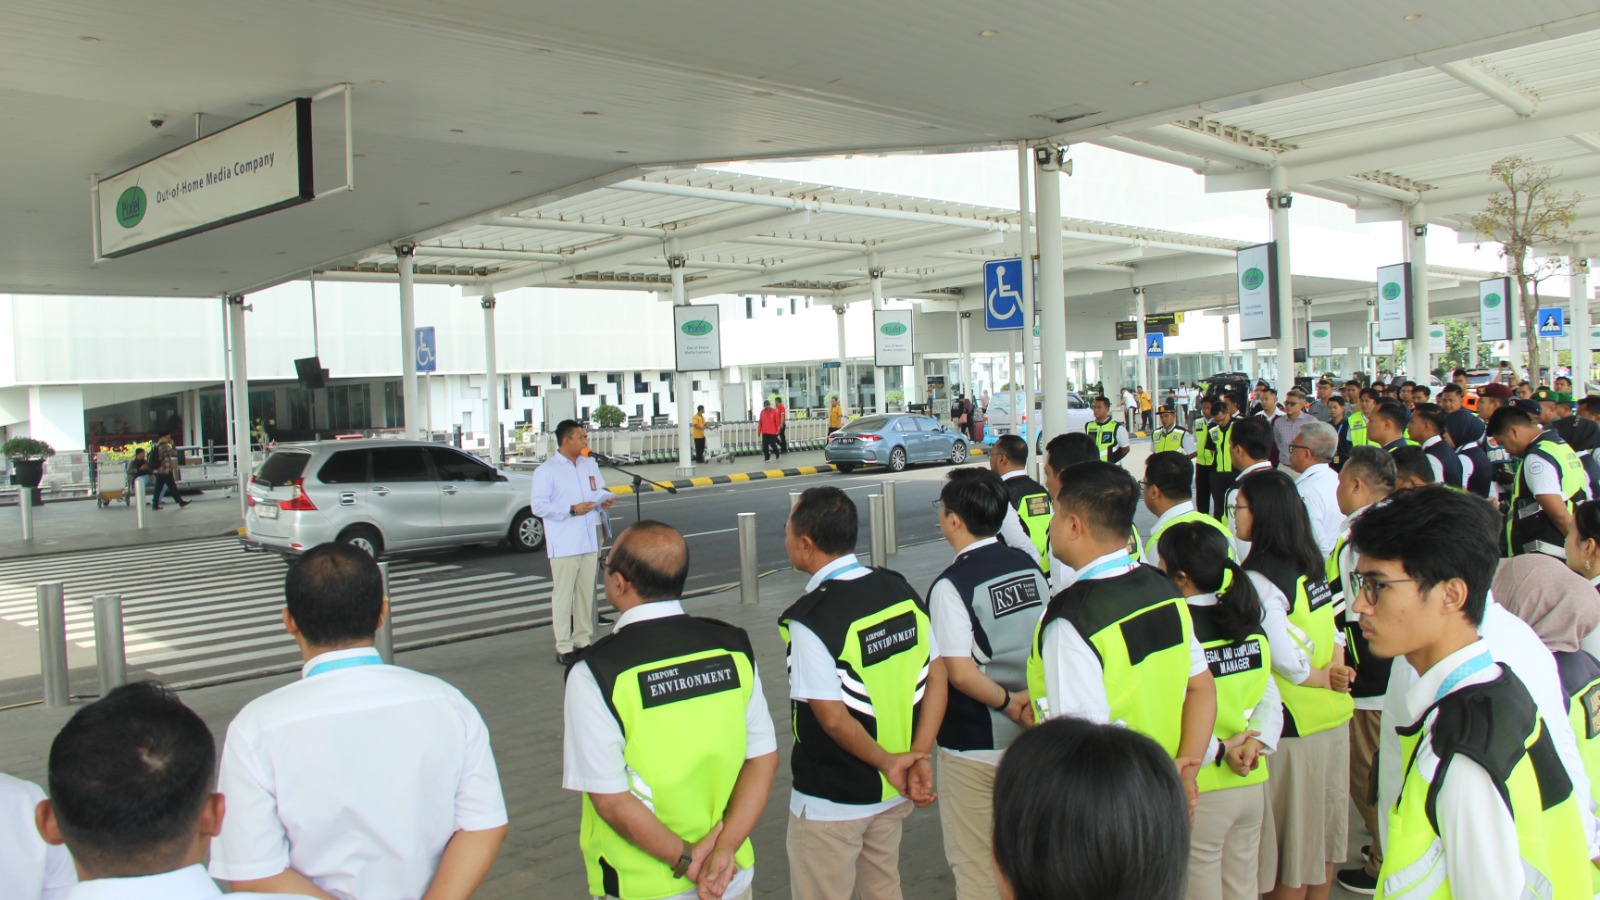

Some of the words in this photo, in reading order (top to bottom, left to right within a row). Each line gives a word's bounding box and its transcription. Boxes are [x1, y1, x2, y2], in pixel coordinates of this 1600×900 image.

[156, 178, 204, 204] Out-of-Home
[205, 166, 232, 186] Media
[233, 152, 275, 176] Company
[122, 195, 140, 217] Pixel
[687, 324, 706, 332] Pixel
[995, 583, 1023, 610] RST
[865, 628, 886, 642] AIRPORT
[1205, 649, 1221, 664] EGAL
[1222, 647, 1233, 660] AND
[1219, 657, 1251, 674] MANAGER
[647, 667, 679, 682] AIRPORT
[650, 668, 732, 697] ENVIRONMENT
